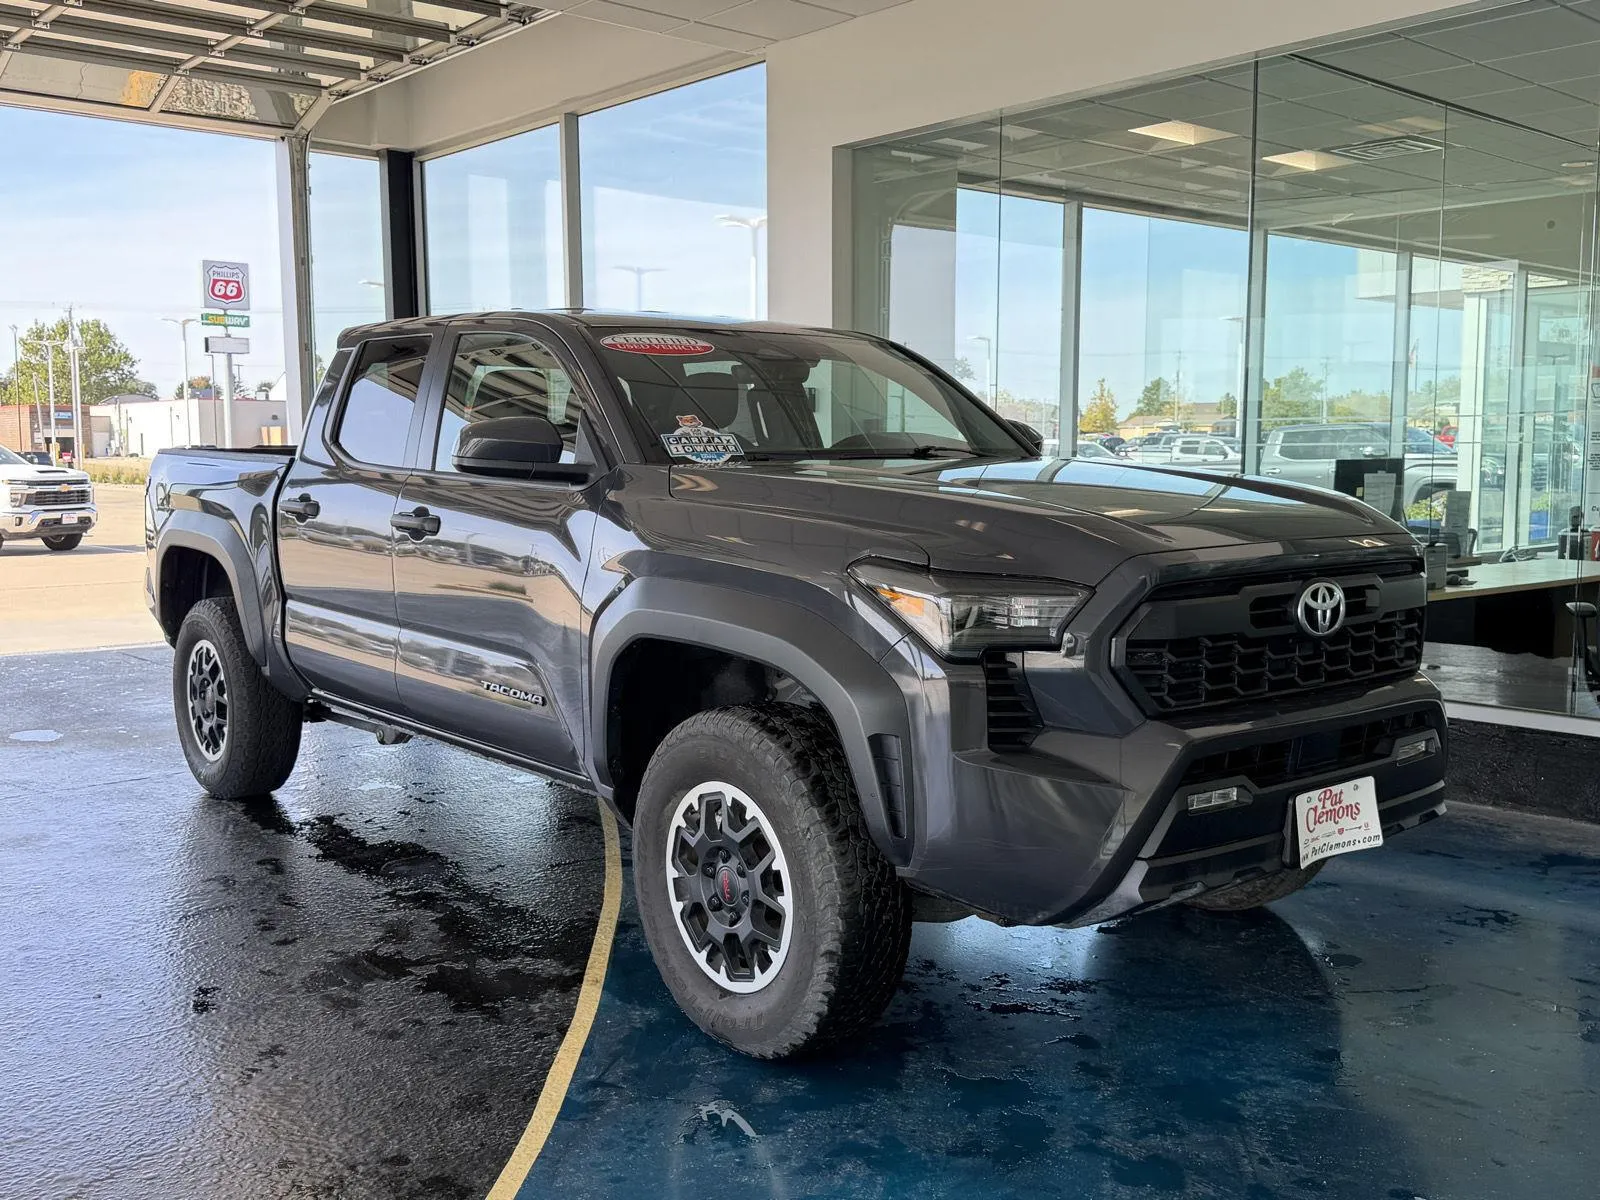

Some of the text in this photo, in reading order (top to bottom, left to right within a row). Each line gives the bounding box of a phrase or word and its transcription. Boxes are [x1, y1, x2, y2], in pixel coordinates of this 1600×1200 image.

[212, 270, 240, 279] PHILLIPS
[214, 281, 239, 297] 66
[207, 315, 249, 326] SUBWAY
[611, 335, 699, 346] CERTIFIED
[668, 436, 733, 445] CARFAX
[480, 680, 543, 706] TACOMA
[1317, 788, 1344, 811] Pat
[1305, 801, 1361, 833] Clemons
